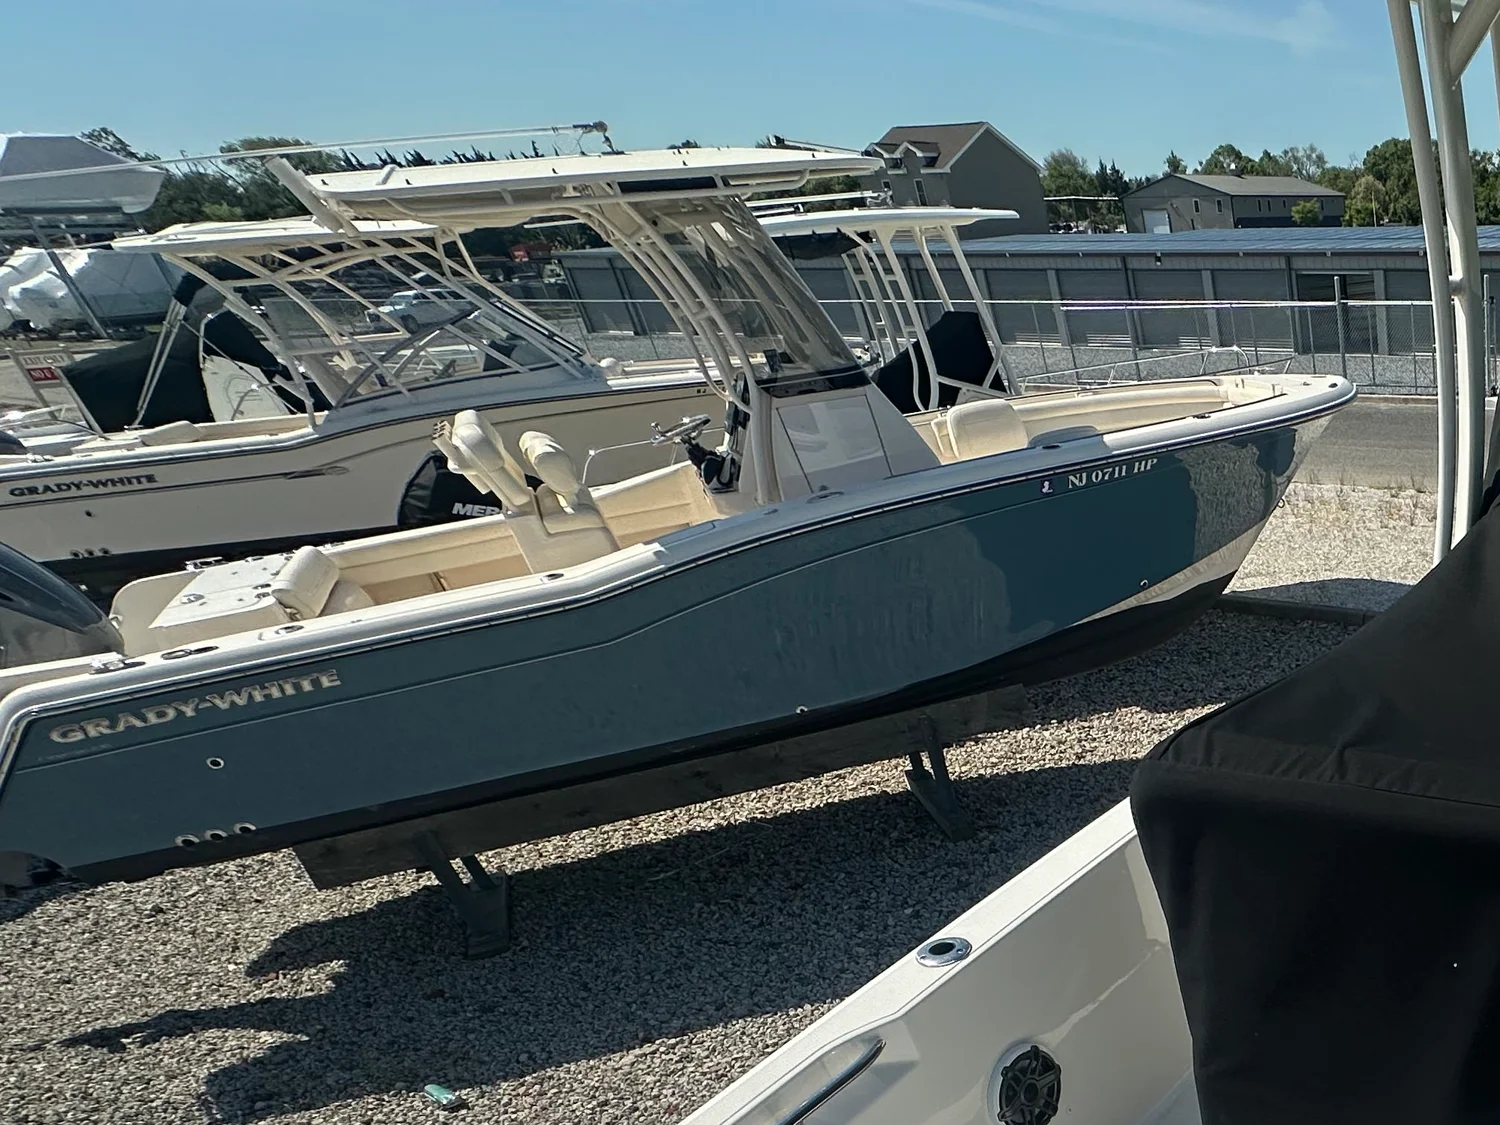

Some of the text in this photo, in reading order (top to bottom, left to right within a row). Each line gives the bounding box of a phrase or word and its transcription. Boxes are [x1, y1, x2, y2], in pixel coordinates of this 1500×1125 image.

[9, 473, 158, 497] GRADY-WHITE
[1068, 458, 1158, 489] NJ 0711 HP
[49, 669, 342, 743] GRADY-WHITE
